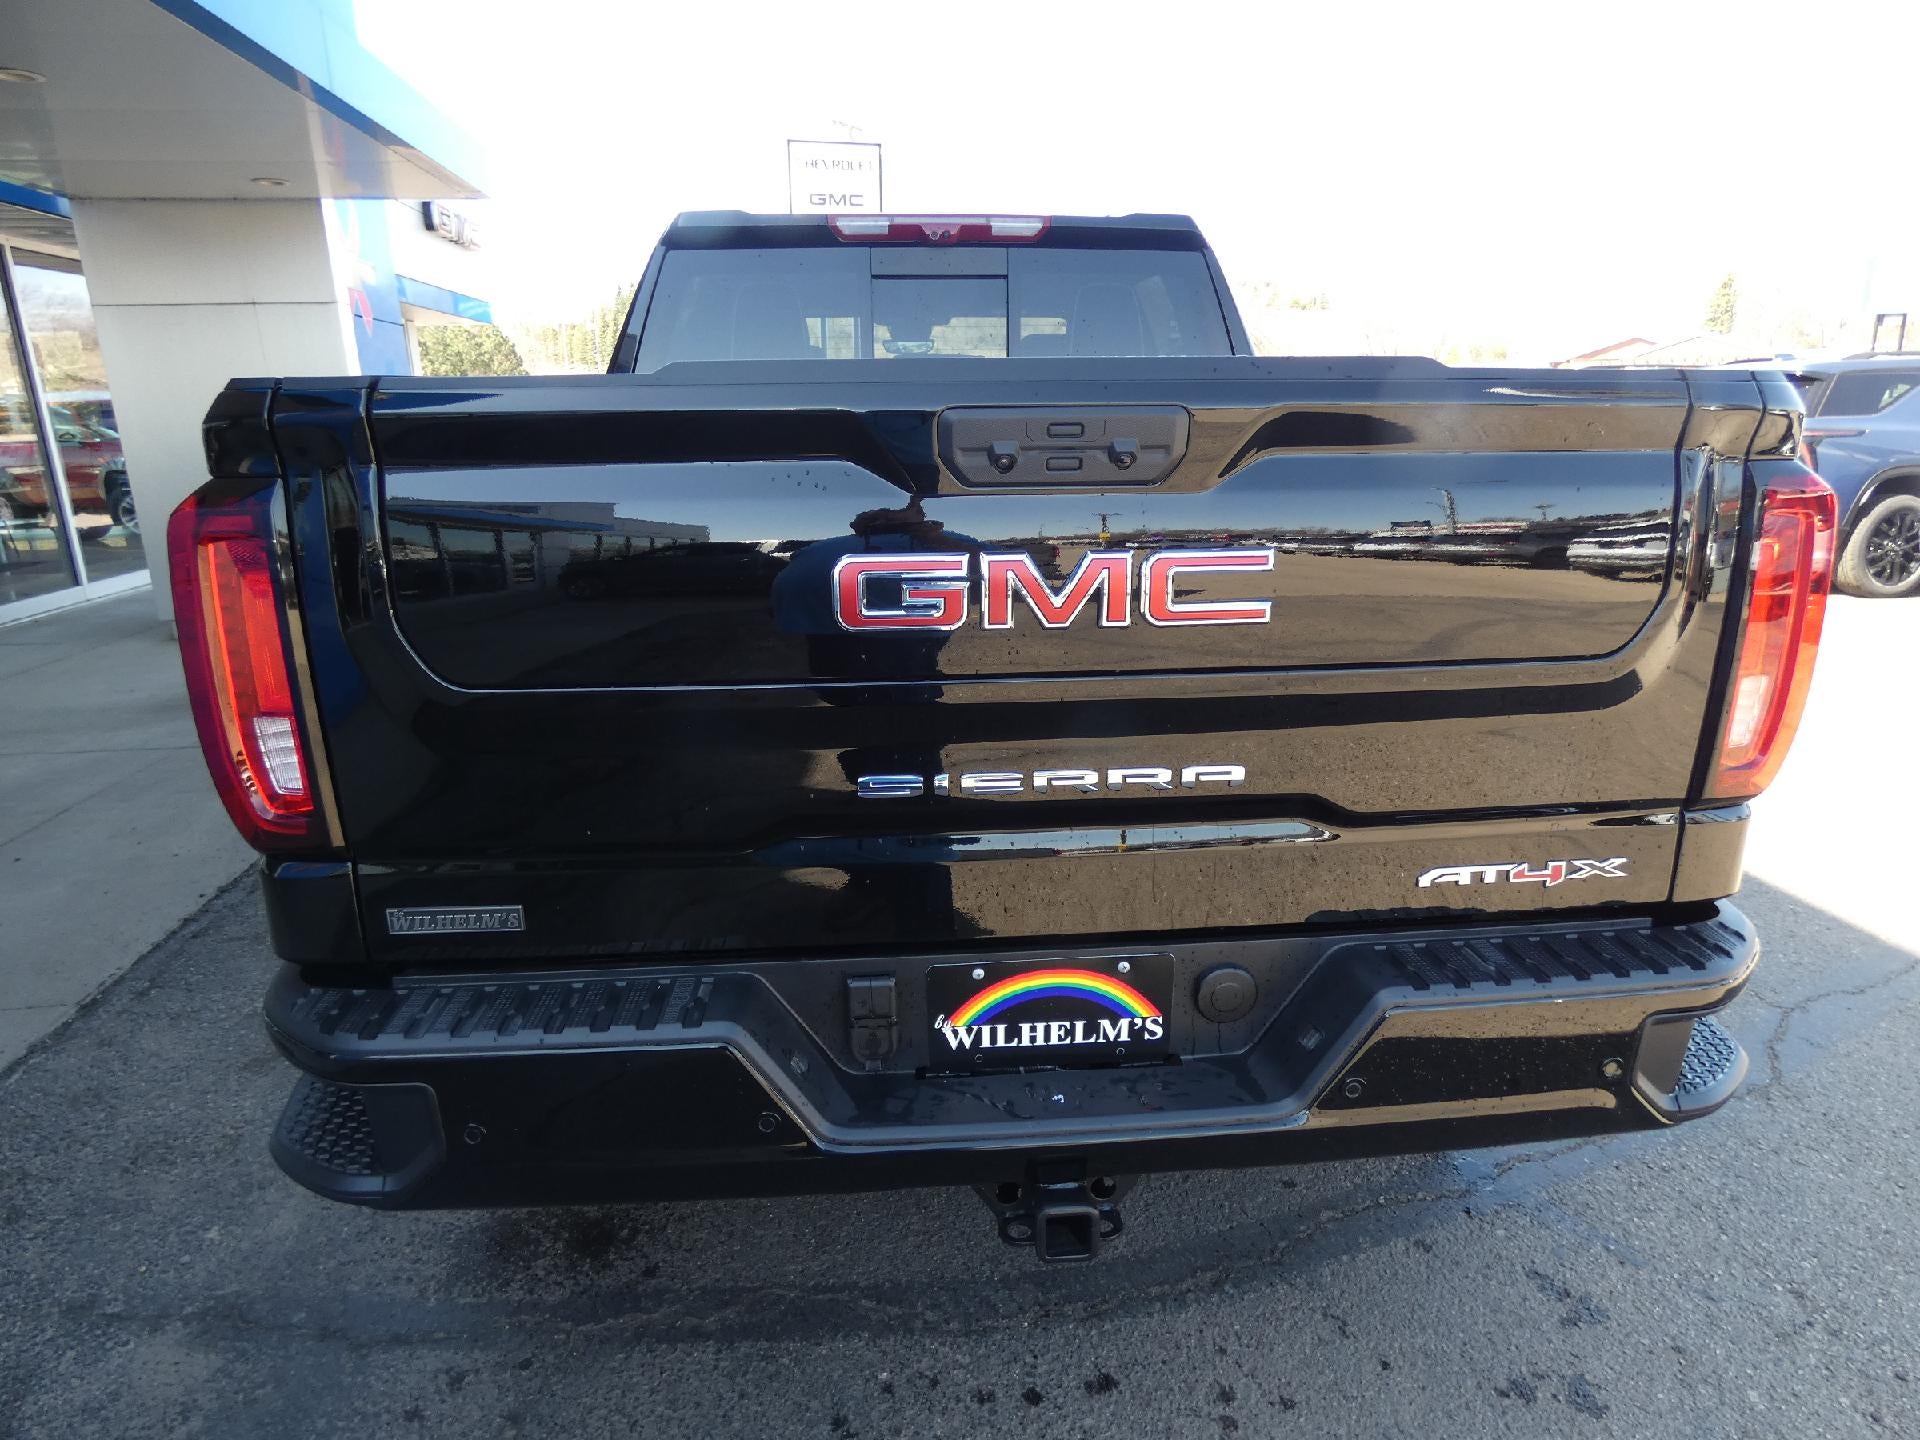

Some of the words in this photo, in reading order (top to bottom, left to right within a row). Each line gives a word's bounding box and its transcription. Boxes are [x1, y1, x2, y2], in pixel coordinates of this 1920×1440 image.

[801, 159, 873, 171] HEVROLET
[809, 193, 864, 207] GMC
[831, 548, 1275, 631] GMC
[857, 764, 1246, 799] SIERRA
[1416, 857, 1627, 888] AT4X
[392, 913, 519, 930] WILHELM'S
[944, 1015, 1164, 1051] WILHELM'S
